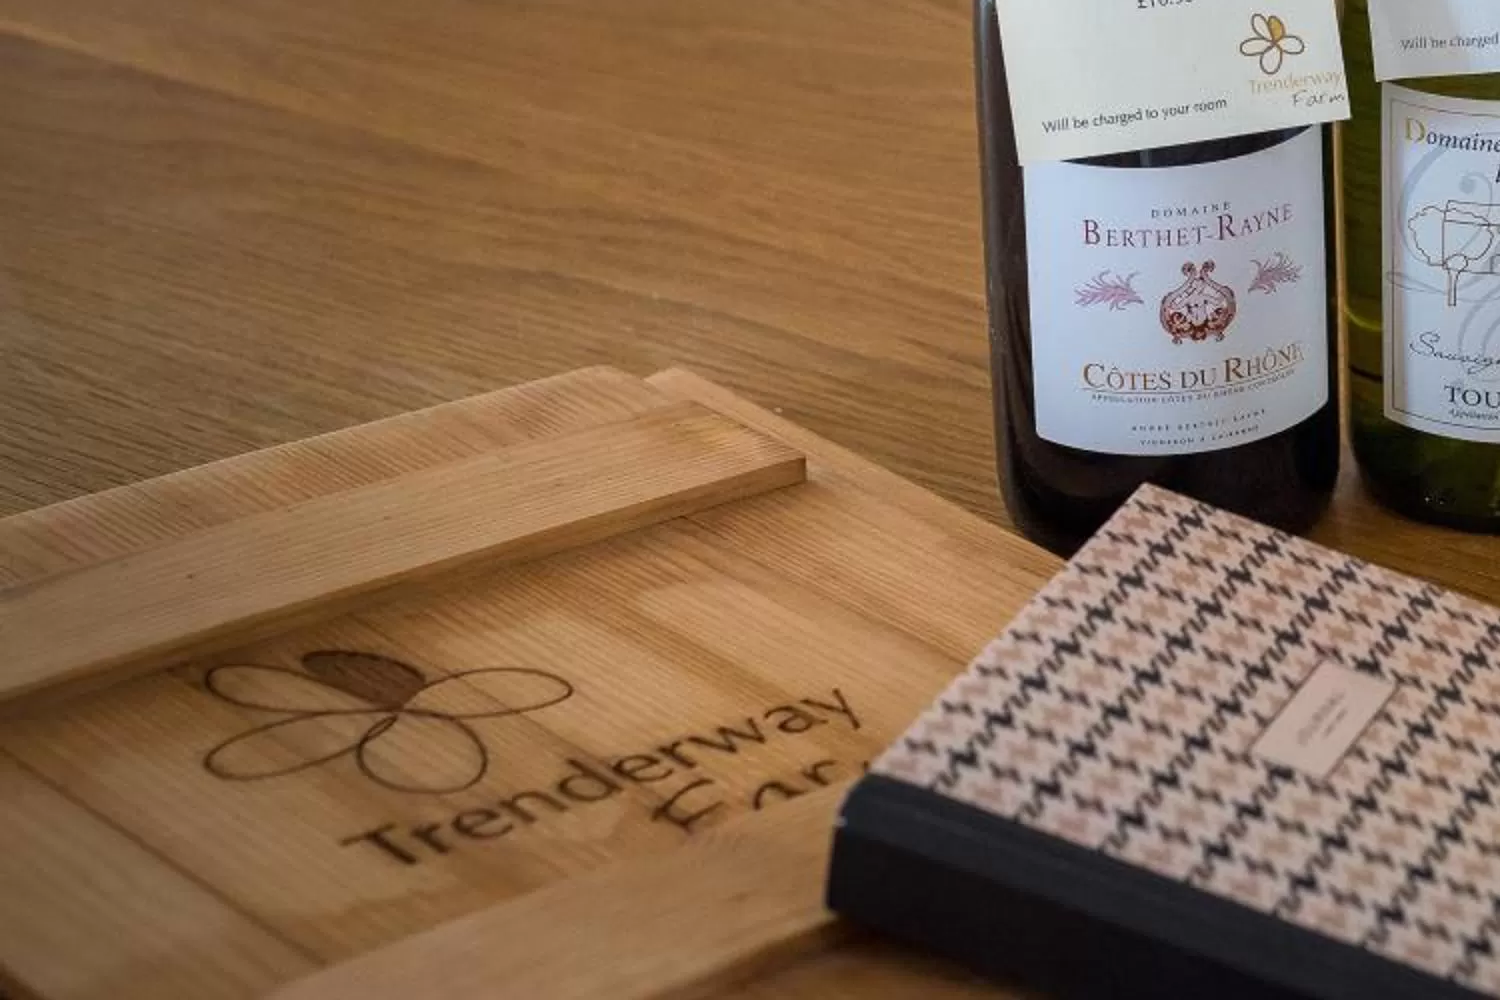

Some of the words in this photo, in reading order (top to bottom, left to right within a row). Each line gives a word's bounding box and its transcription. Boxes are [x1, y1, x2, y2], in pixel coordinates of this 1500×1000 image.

[1401, 34, 1428, 50] Will
[1431, 33, 1447, 49] be
[1449, 32, 1499, 50] charged
[1248, 71, 1345, 96] Trenderway
[1291, 88, 1345, 108] Farm
[1042, 116, 1069, 133] Will
[1073, 112, 1089, 129] be
[1092, 108, 1142, 129] charged
[1145, 104, 1158, 120] to
[1161, 103, 1191, 121] your
[1193, 97, 1228, 114] room
[1151, 201, 1231, 219] DOMAINE
[1083, 203, 1293, 249] BERTHET-RAYNE
[1082, 362, 1172, 391] CÔTES
[1180, 367, 1216, 389] DU
[1223, 341, 1304, 384] RHÔNE
[340, 687, 861, 866] Trenderway
